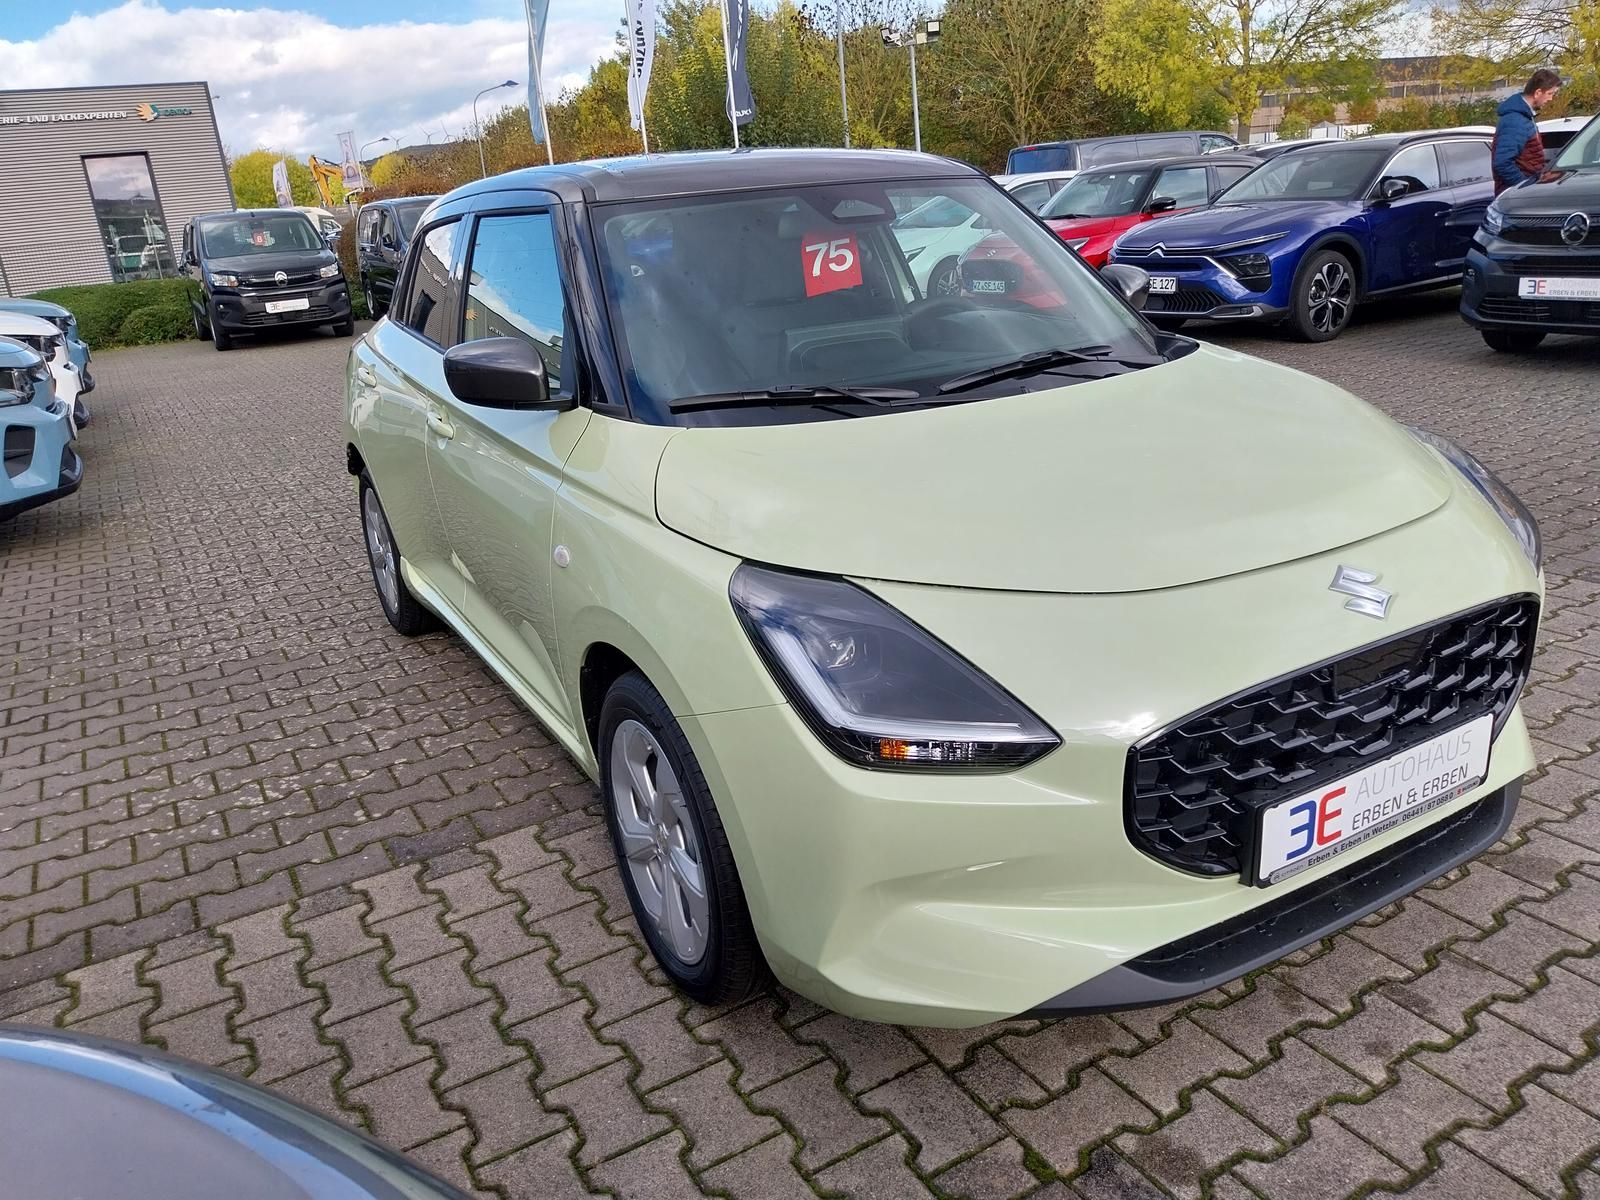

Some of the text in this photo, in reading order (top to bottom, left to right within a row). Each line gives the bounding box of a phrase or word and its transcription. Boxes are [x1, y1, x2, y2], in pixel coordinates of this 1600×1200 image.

[27, 114, 49, 123] UND
[52, 111, 128, 122] LACKEXPERTEN
[805, 238, 854, 277] 75
[1159, 279, 1175, 290] 127
[1354, 730, 1472, 803] AUTOHAUS
[1352, 762, 1469, 830] ERBEN & ERBEN
[1307, 853, 1331, 867] Erben
[1332, 846, 1339, 856] &
[1340, 837, 1362, 851] Erben
[1363, 831, 1370, 840] in
[1371, 818, 1399, 836] Wetzlar
